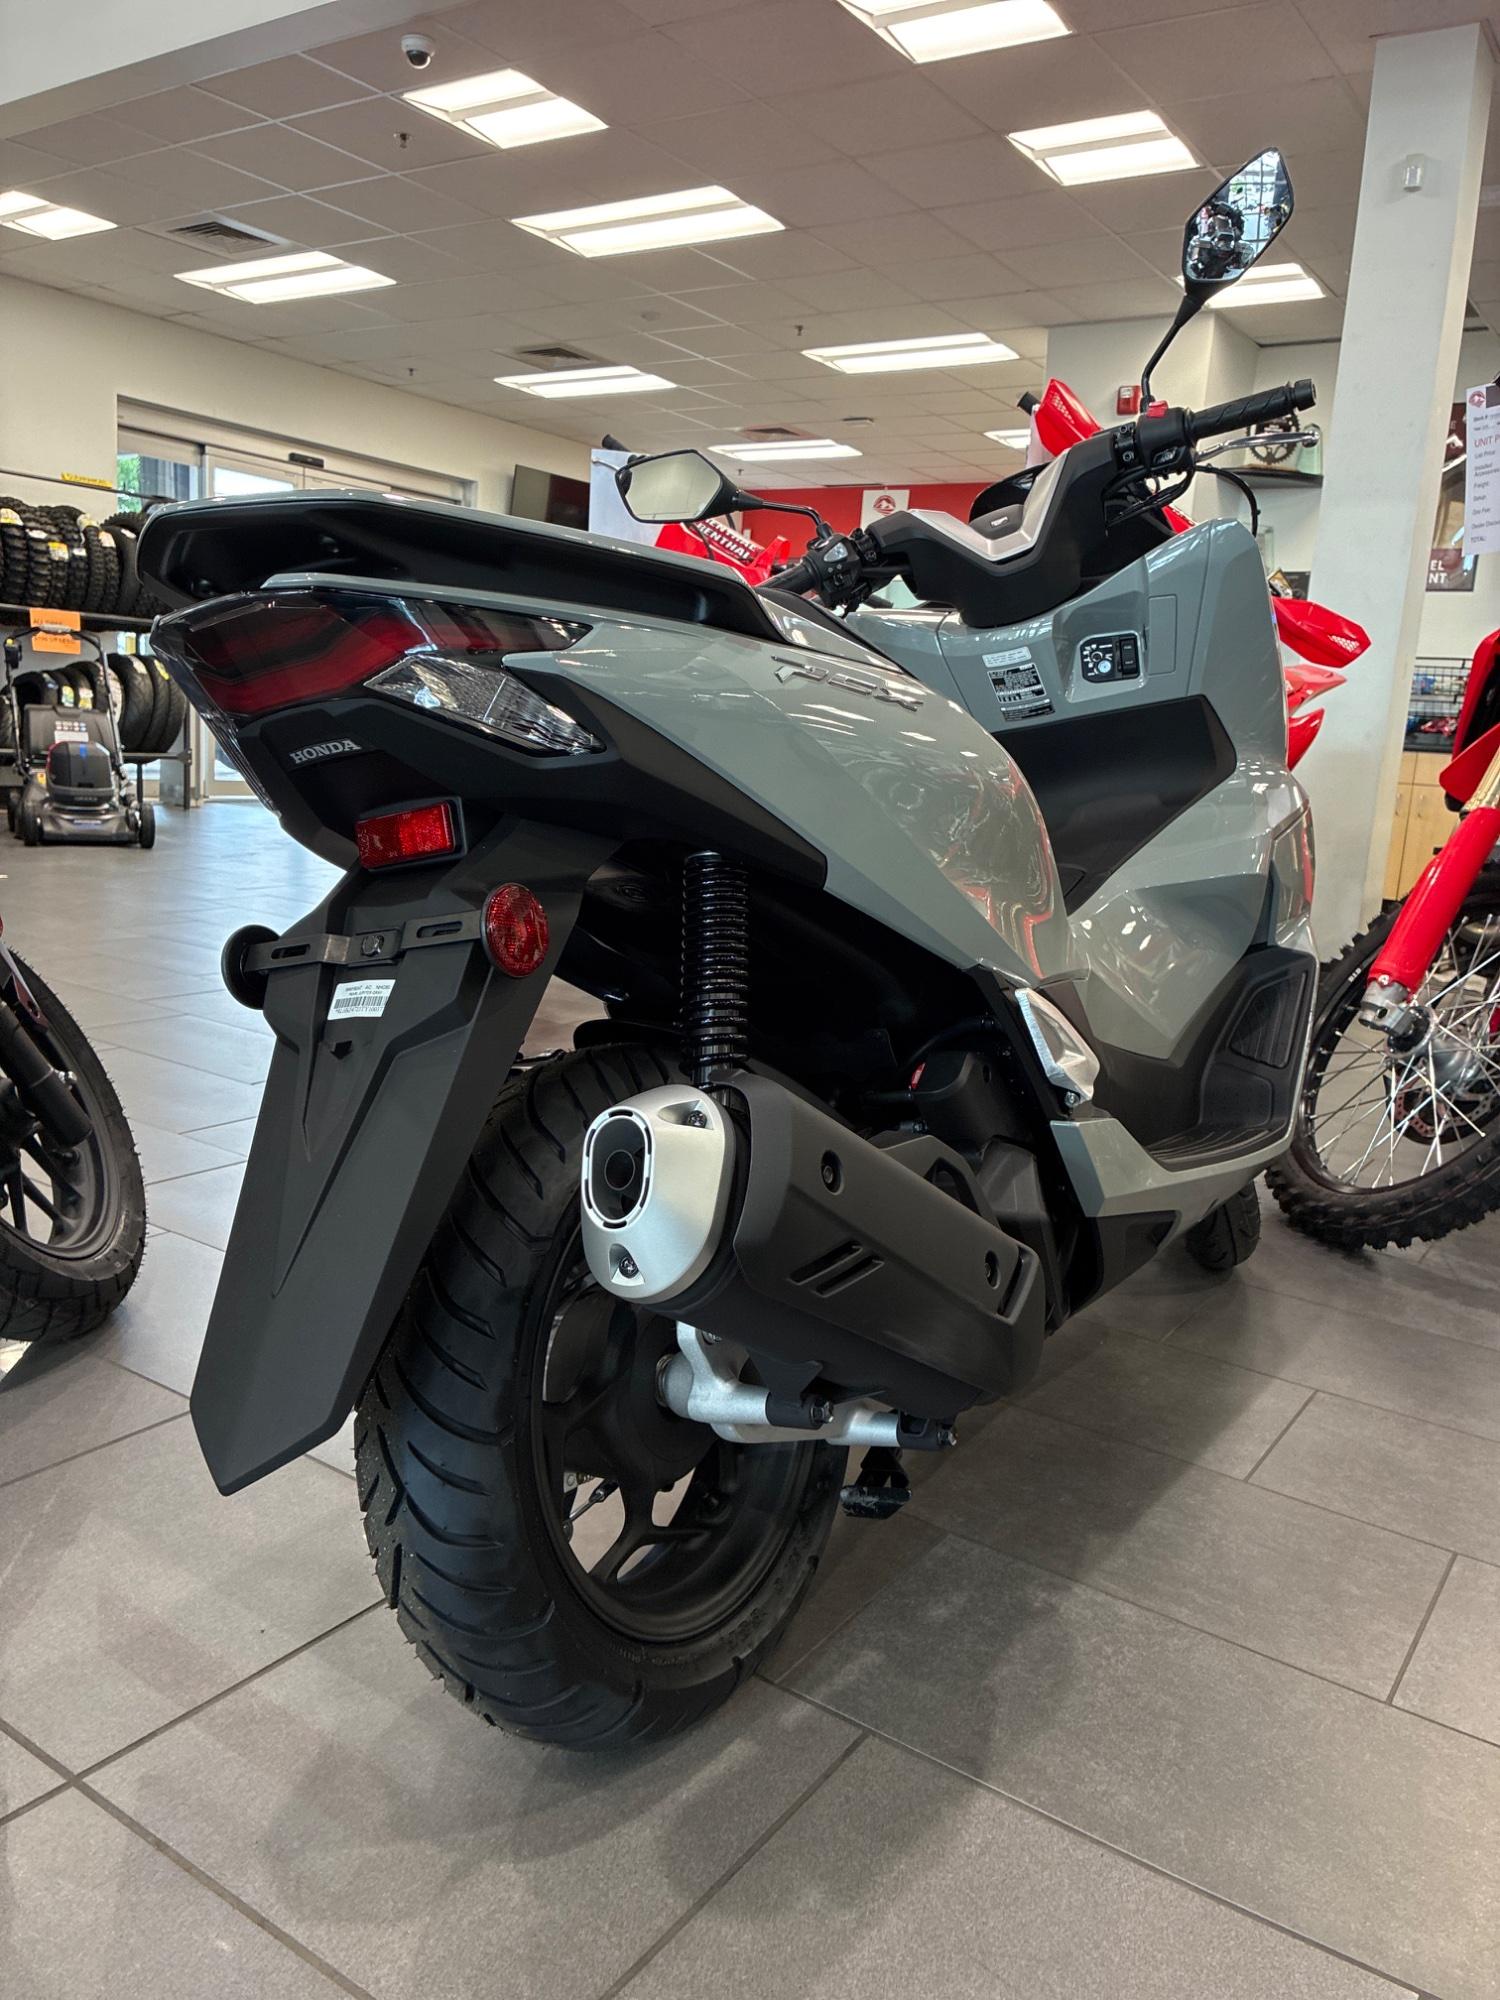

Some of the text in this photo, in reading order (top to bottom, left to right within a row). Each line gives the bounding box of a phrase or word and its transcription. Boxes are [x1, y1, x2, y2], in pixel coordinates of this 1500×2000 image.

[1474, 436, 1492, 448] UNIT
[771, 655, 924, 712] PCX
[289, 739, 362, 764] HONDA
